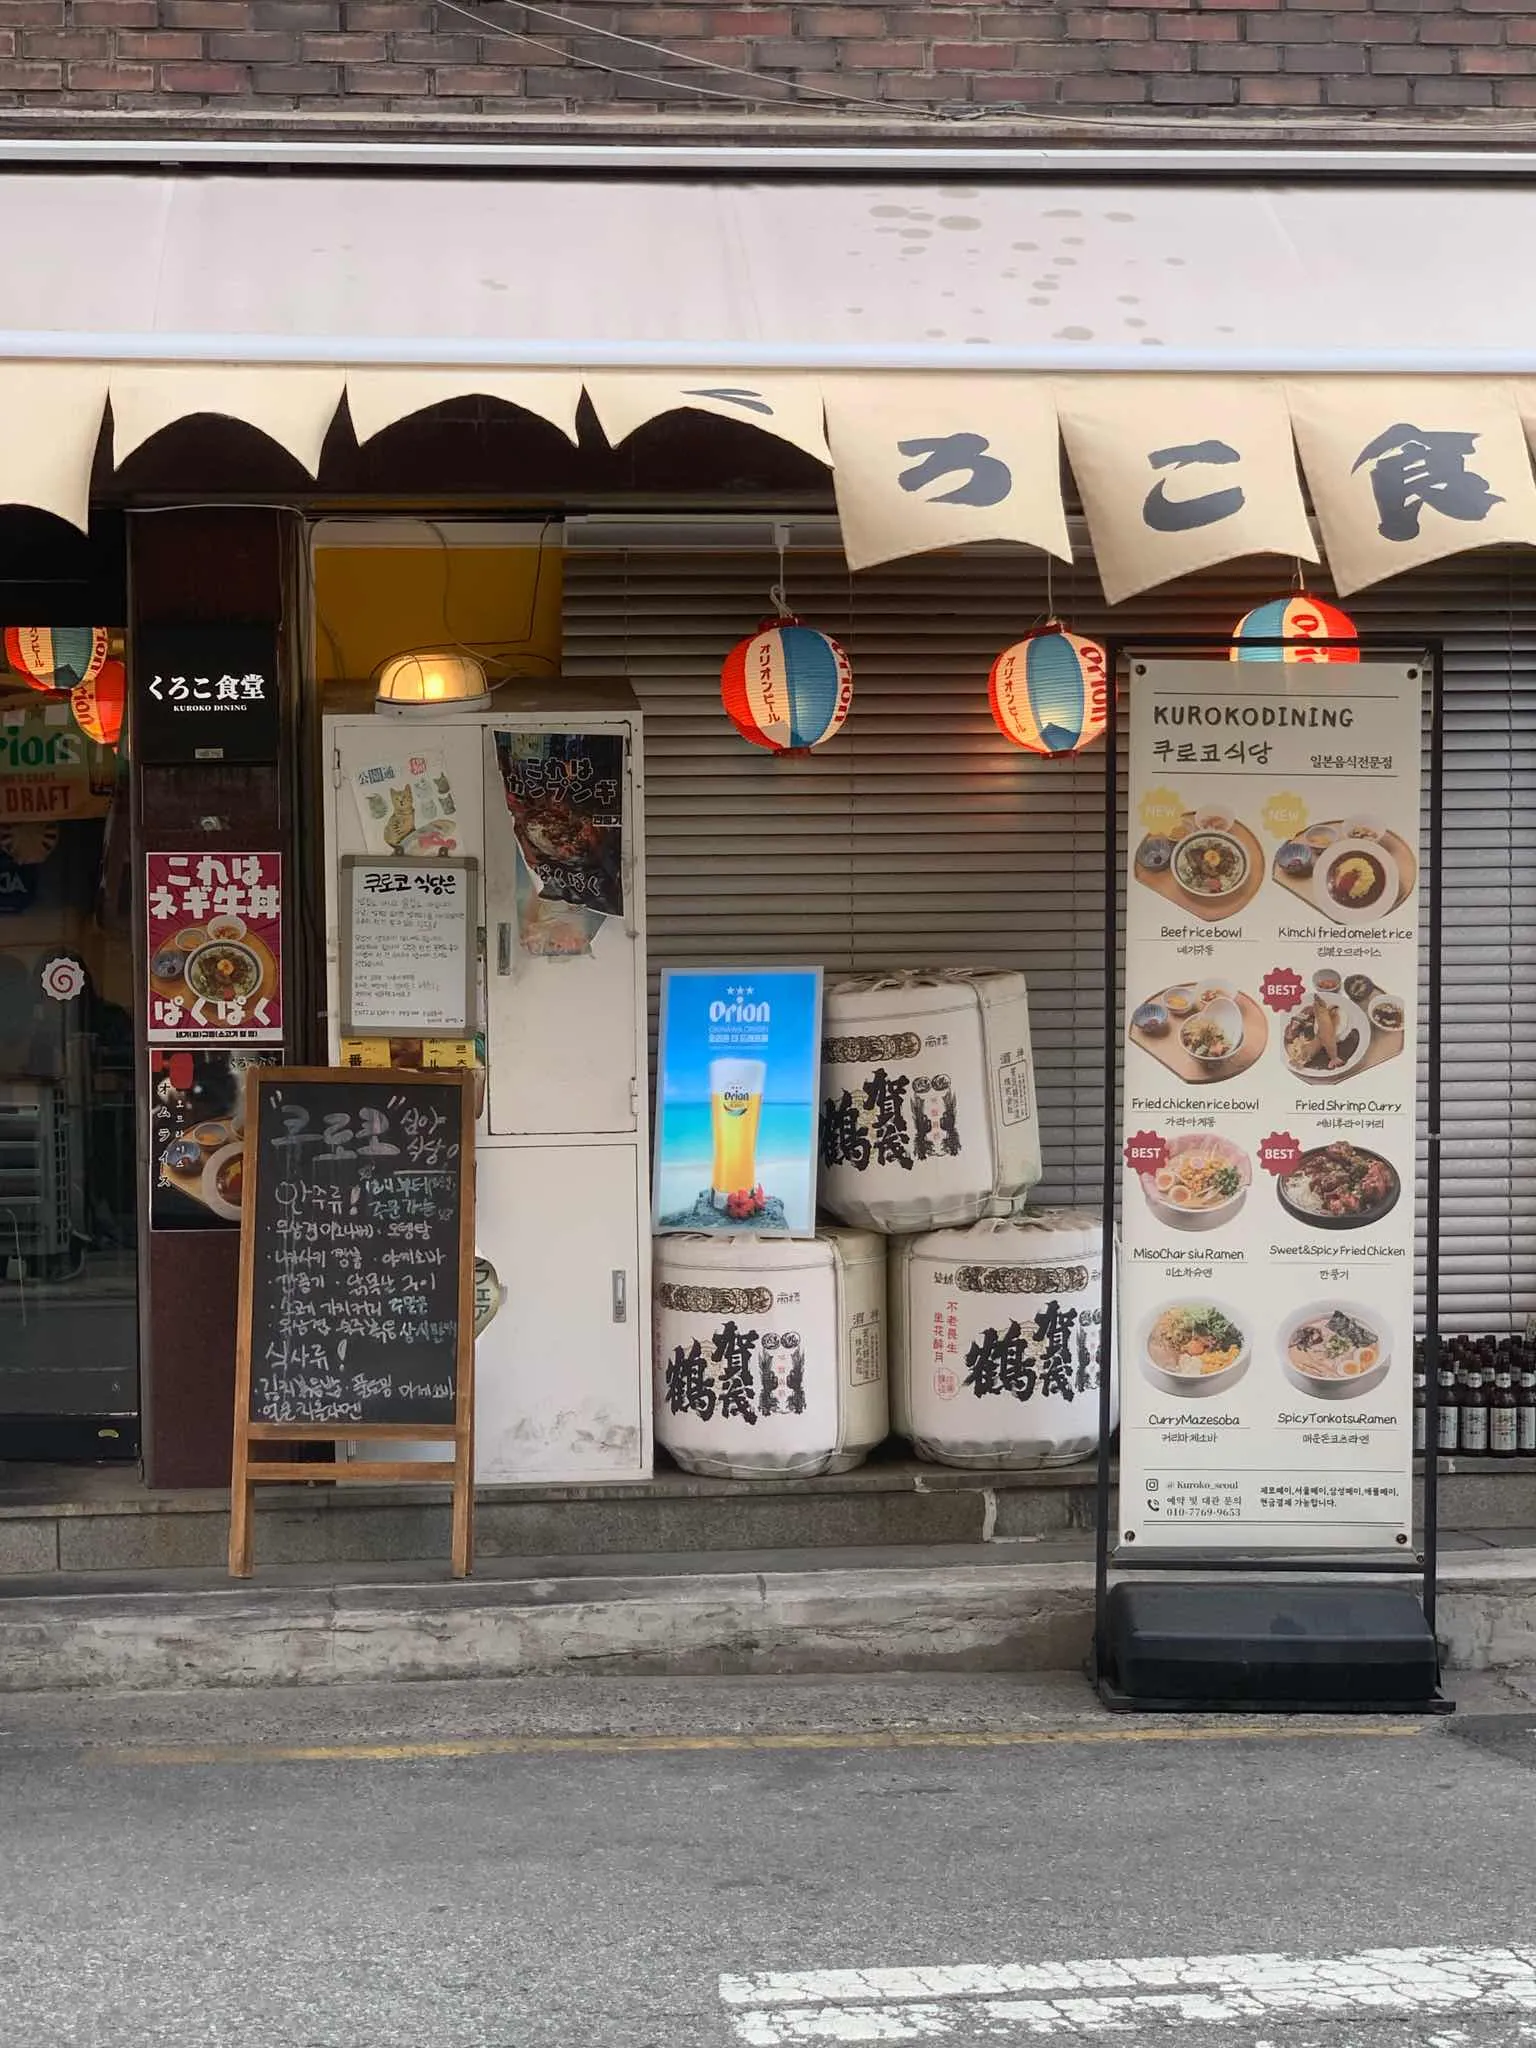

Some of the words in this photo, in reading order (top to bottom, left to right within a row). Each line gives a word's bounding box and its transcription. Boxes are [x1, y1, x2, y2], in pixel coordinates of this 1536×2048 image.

[148, 673, 266, 700] くろこ食堂
[173, 704, 212, 712] KUROKO
[1153, 705, 1354, 728] KUROKODINING
[1152, 739, 1273, 766] 쿠로코식당
[1310, 755, 1393, 770] 일본음식전문점
[526, 757, 593, 780] これは
[507, 778, 617, 805] カンプンギ
[1268, 809, 1299, 822] NEW
[167, 855, 263, 887] これは
[363, 873, 411, 893] 쿠로코
[414, 874, 456, 895] 식당은
[149, 885, 281, 919] ネギ牛丼
[1267, 984, 1297, 996] BEST
[154, 995, 271, 1027] ぱくぱく
[709, 996, 770, 1022] Orion
[1131, 1147, 1161, 1159] BEST
[1264, 1148, 1295, 1160] BEST
